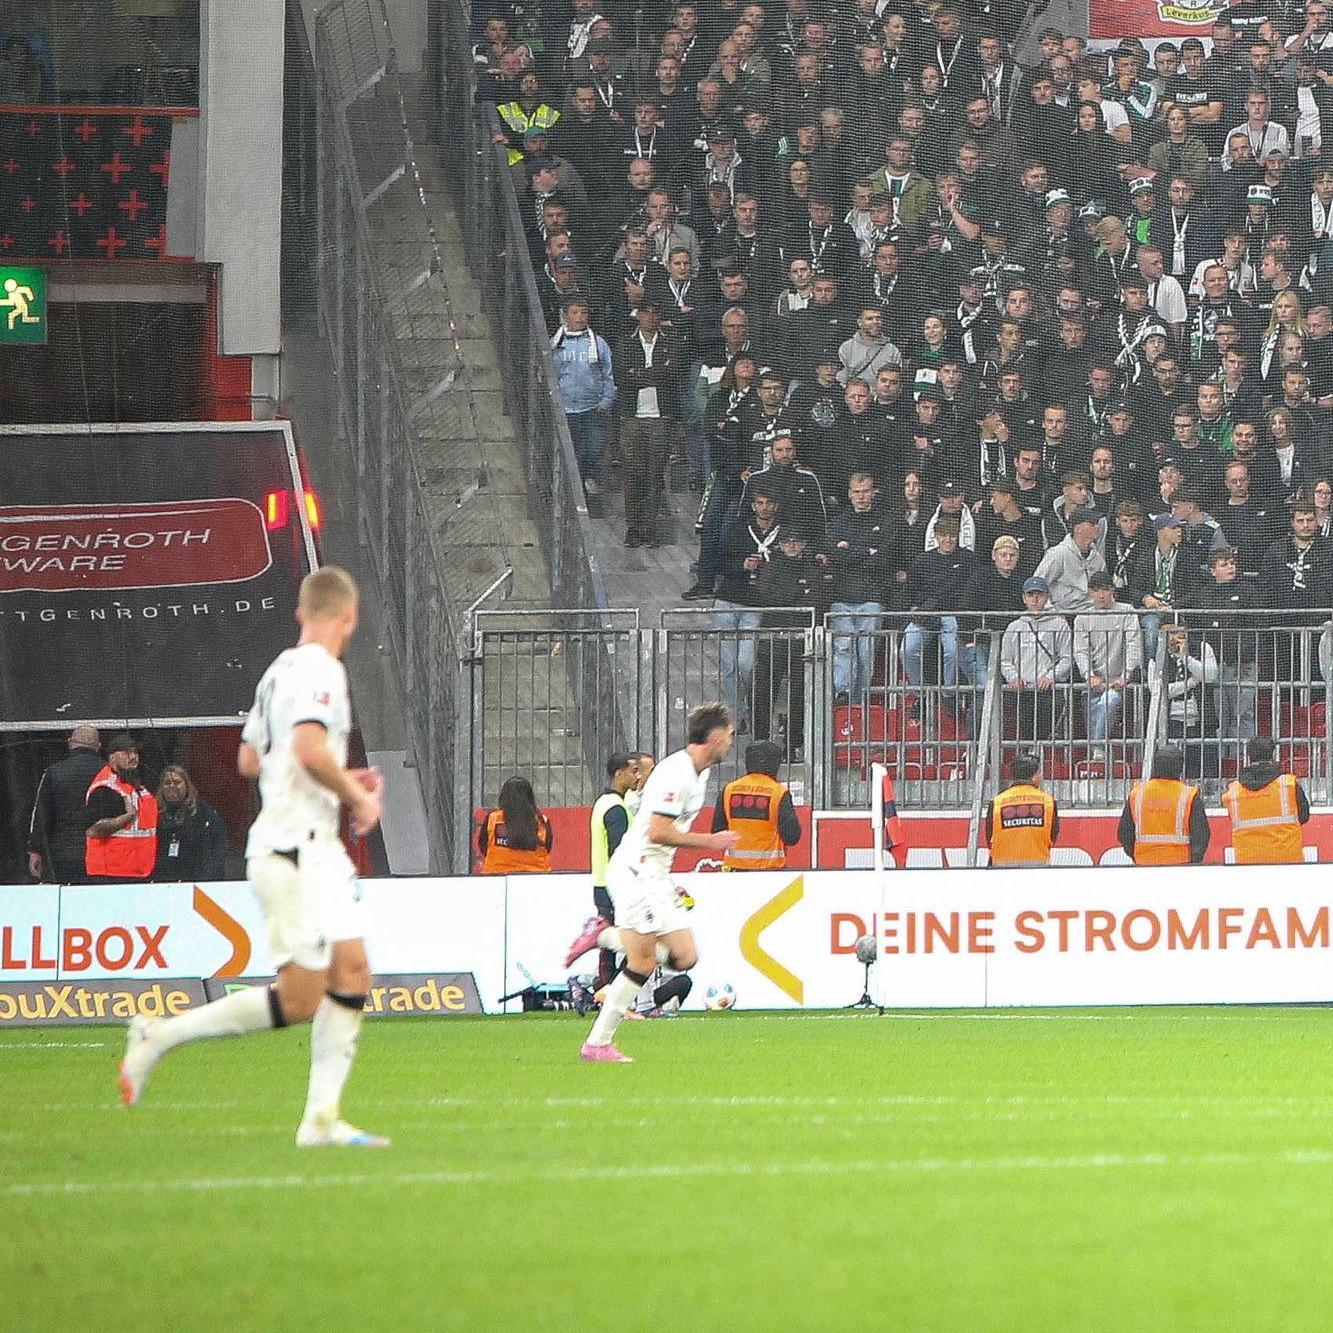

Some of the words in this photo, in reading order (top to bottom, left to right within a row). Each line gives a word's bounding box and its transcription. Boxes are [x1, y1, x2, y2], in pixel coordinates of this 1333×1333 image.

[0, 529, 213, 552] GENROTH
[0, 554, 127, 573] WARE
[0, 596, 276, 622] TGENROTH.DE
[1003, 817, 1043, 828] SECURITAS
[830, 911, 996, 955] DEINE
[2, 925, 170, 972] LLBOX
